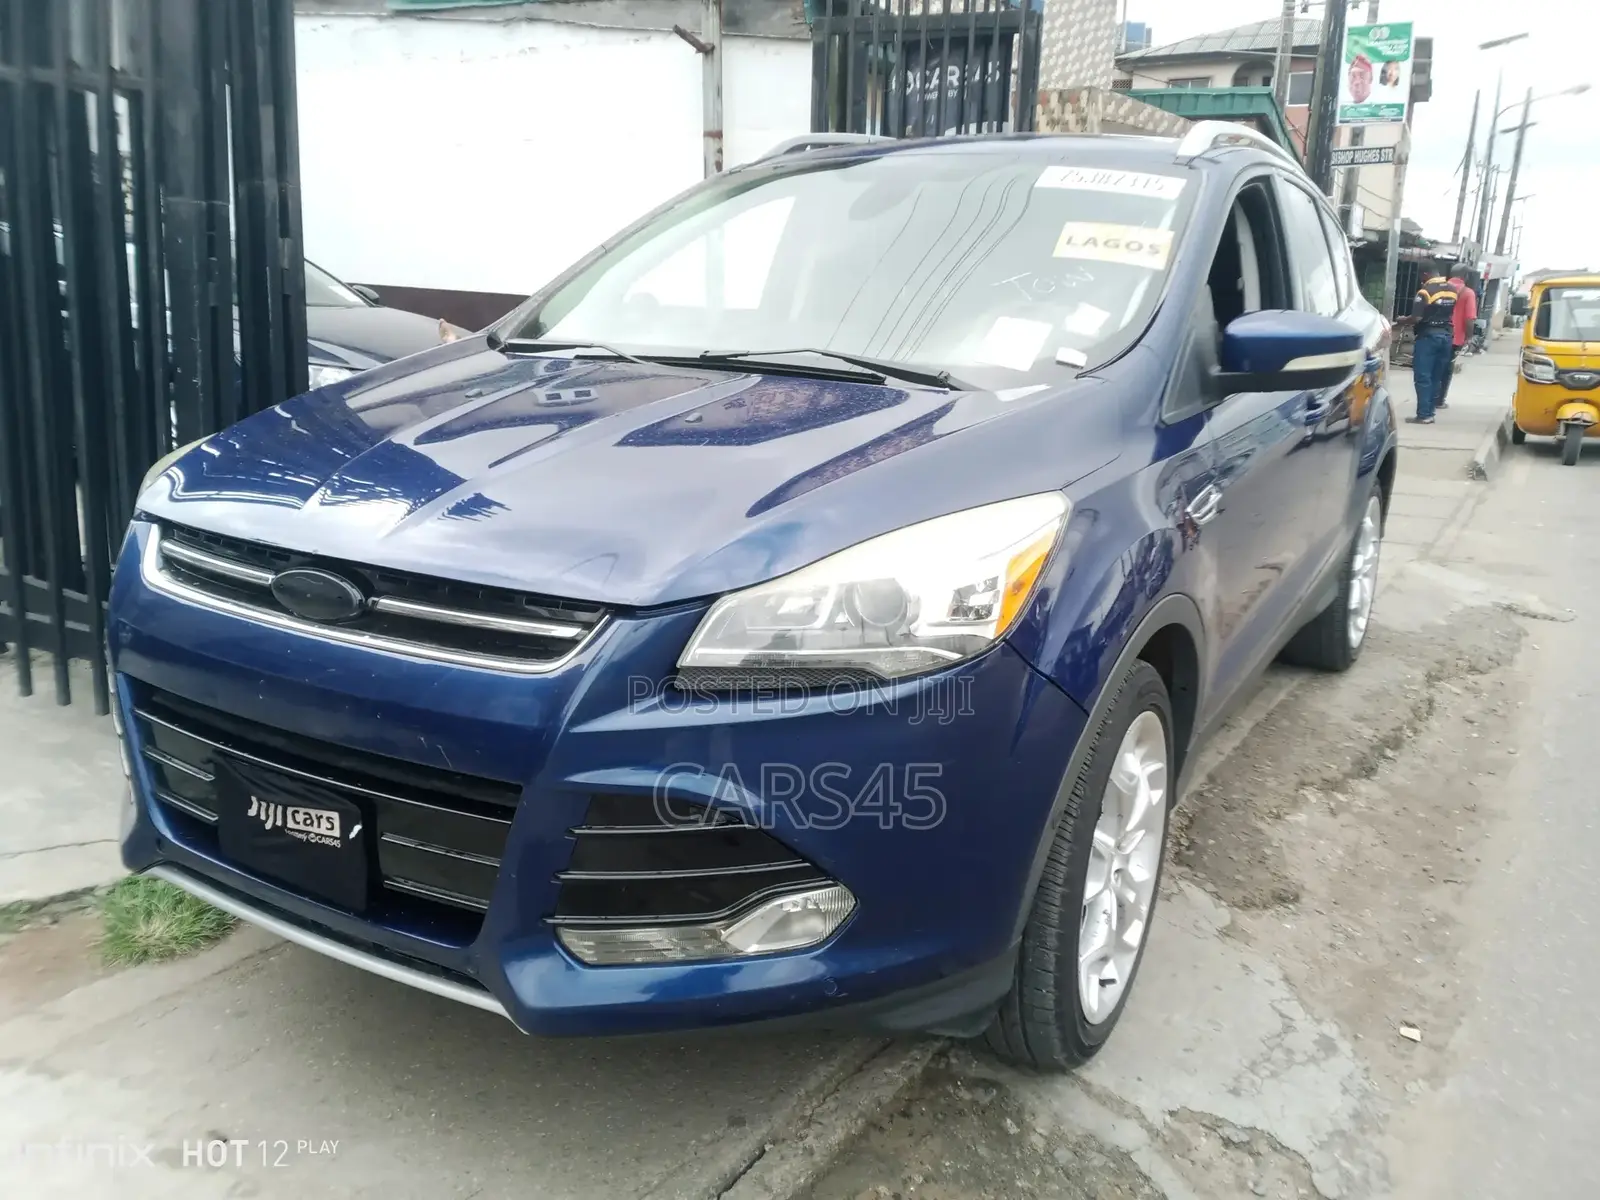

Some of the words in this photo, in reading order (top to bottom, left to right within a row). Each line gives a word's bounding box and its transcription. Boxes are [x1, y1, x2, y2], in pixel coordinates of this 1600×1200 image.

[1354, 149, 1380, 163] HUGHES
[1380, 148, 1394, 162] STR
[1065, 235, 1162, 255] LAGOS
[291, 809, 335, 831] cars
